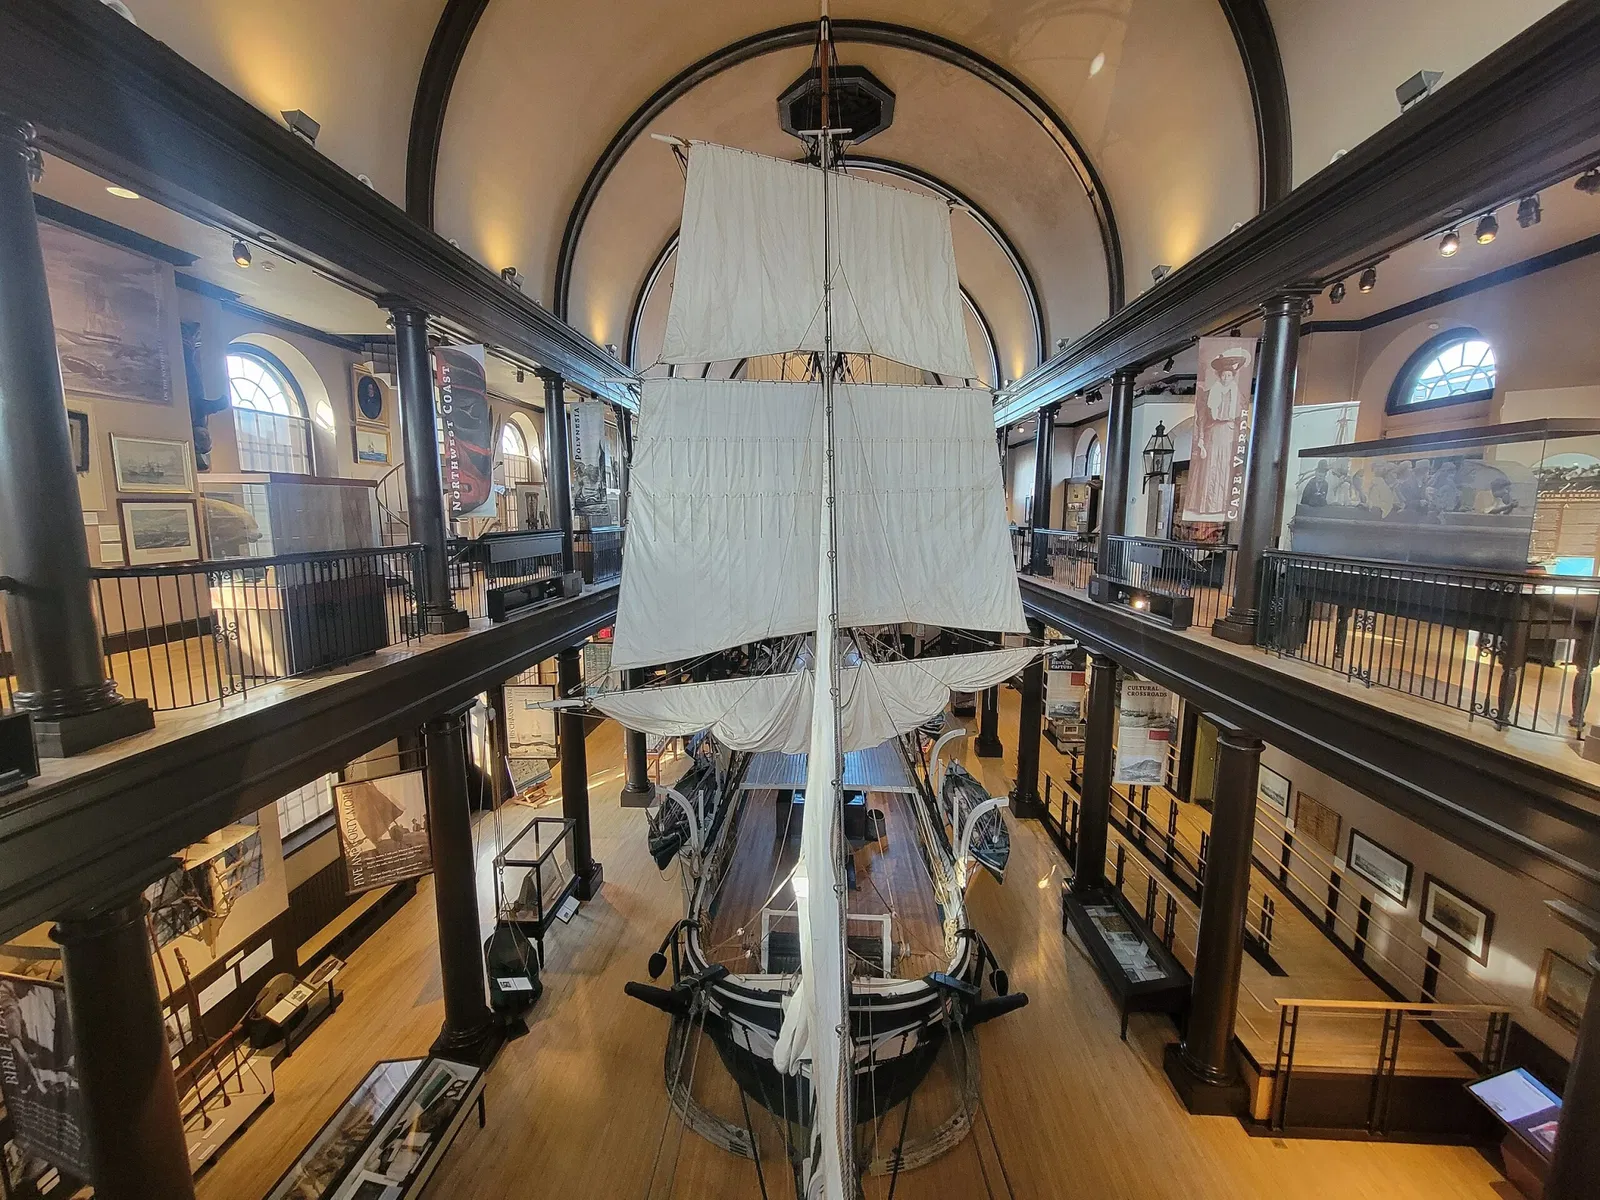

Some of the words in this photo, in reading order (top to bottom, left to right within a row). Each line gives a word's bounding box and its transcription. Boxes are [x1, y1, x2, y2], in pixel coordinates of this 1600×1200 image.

[442, 366, 453, 414] COAST
[574, 407, 582, 460] POLYNESIA
[1233, 409, 1248, 468] VERDE
[446, 421, 462, 512] NORTHWEST
[1228, 475, 1242, 520] CAPE
[343, 789, 356, 816] MORE
[352, 868, 365, 887] FIVE
[1, 1043, 19, 1085] BIBLE
